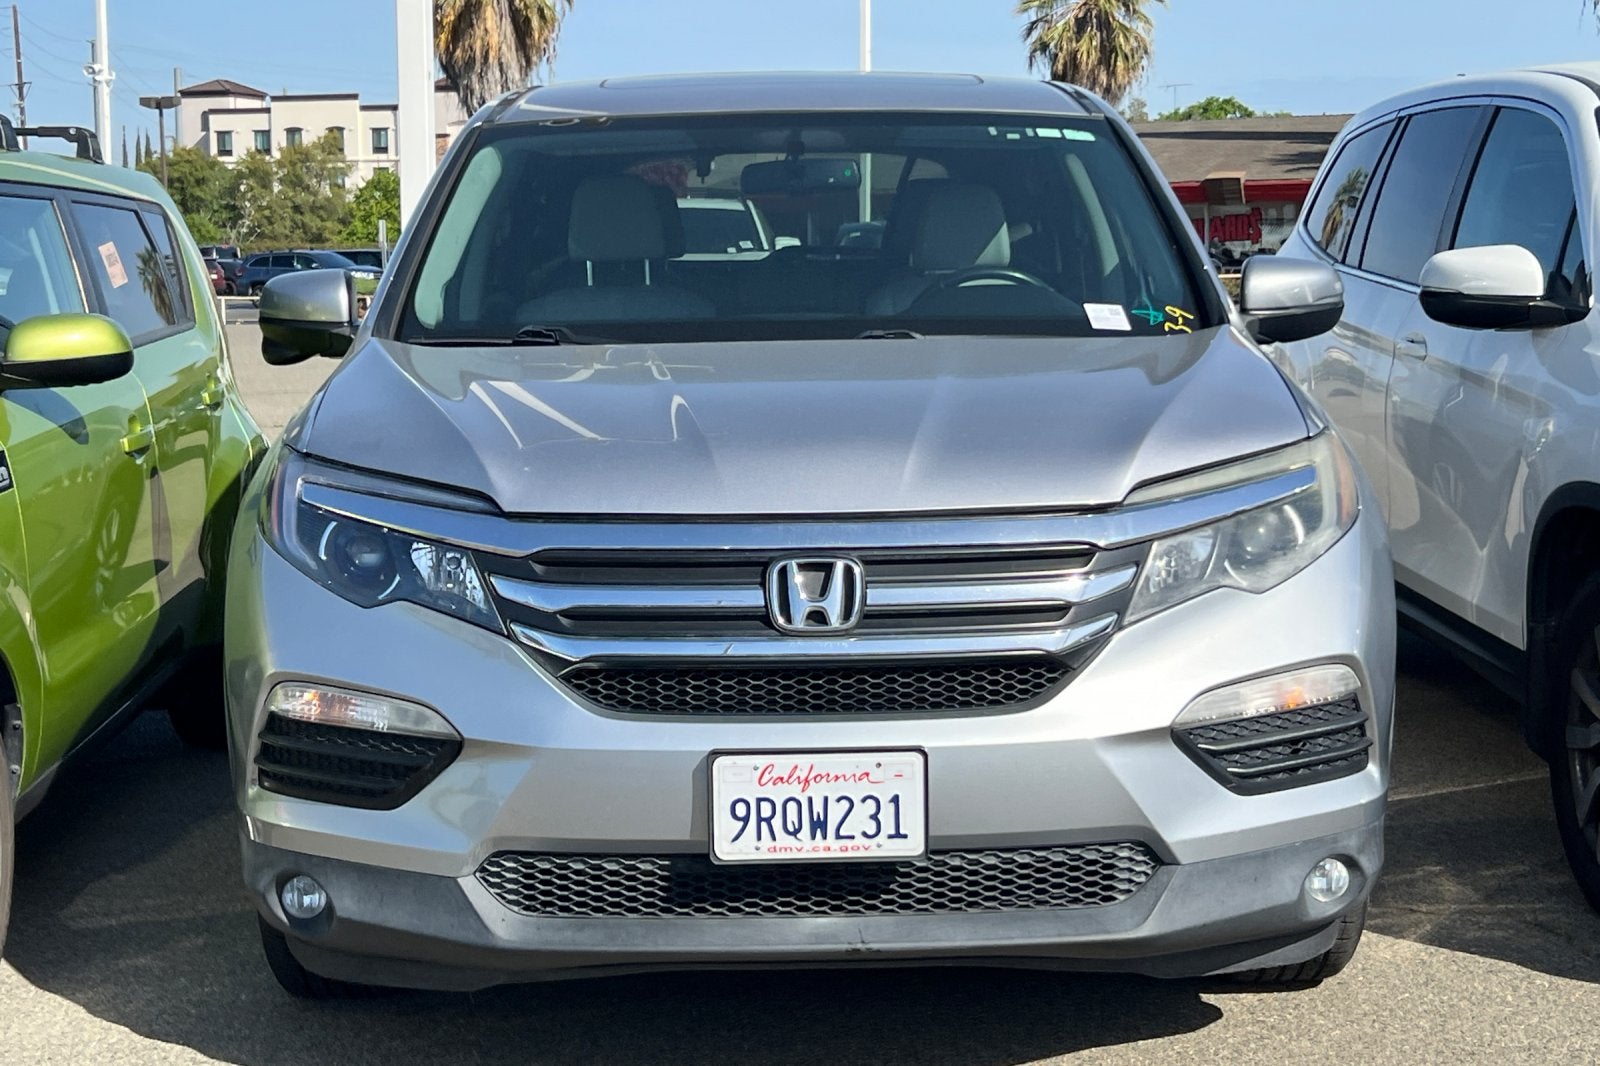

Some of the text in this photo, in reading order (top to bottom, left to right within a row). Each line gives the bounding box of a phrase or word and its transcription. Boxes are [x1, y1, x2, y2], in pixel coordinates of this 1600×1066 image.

[757, 763, 885, 793] California
[729, 793, 909, 843] 9RQW231
[767, 843, 872, 854] dmv.ca.gov
